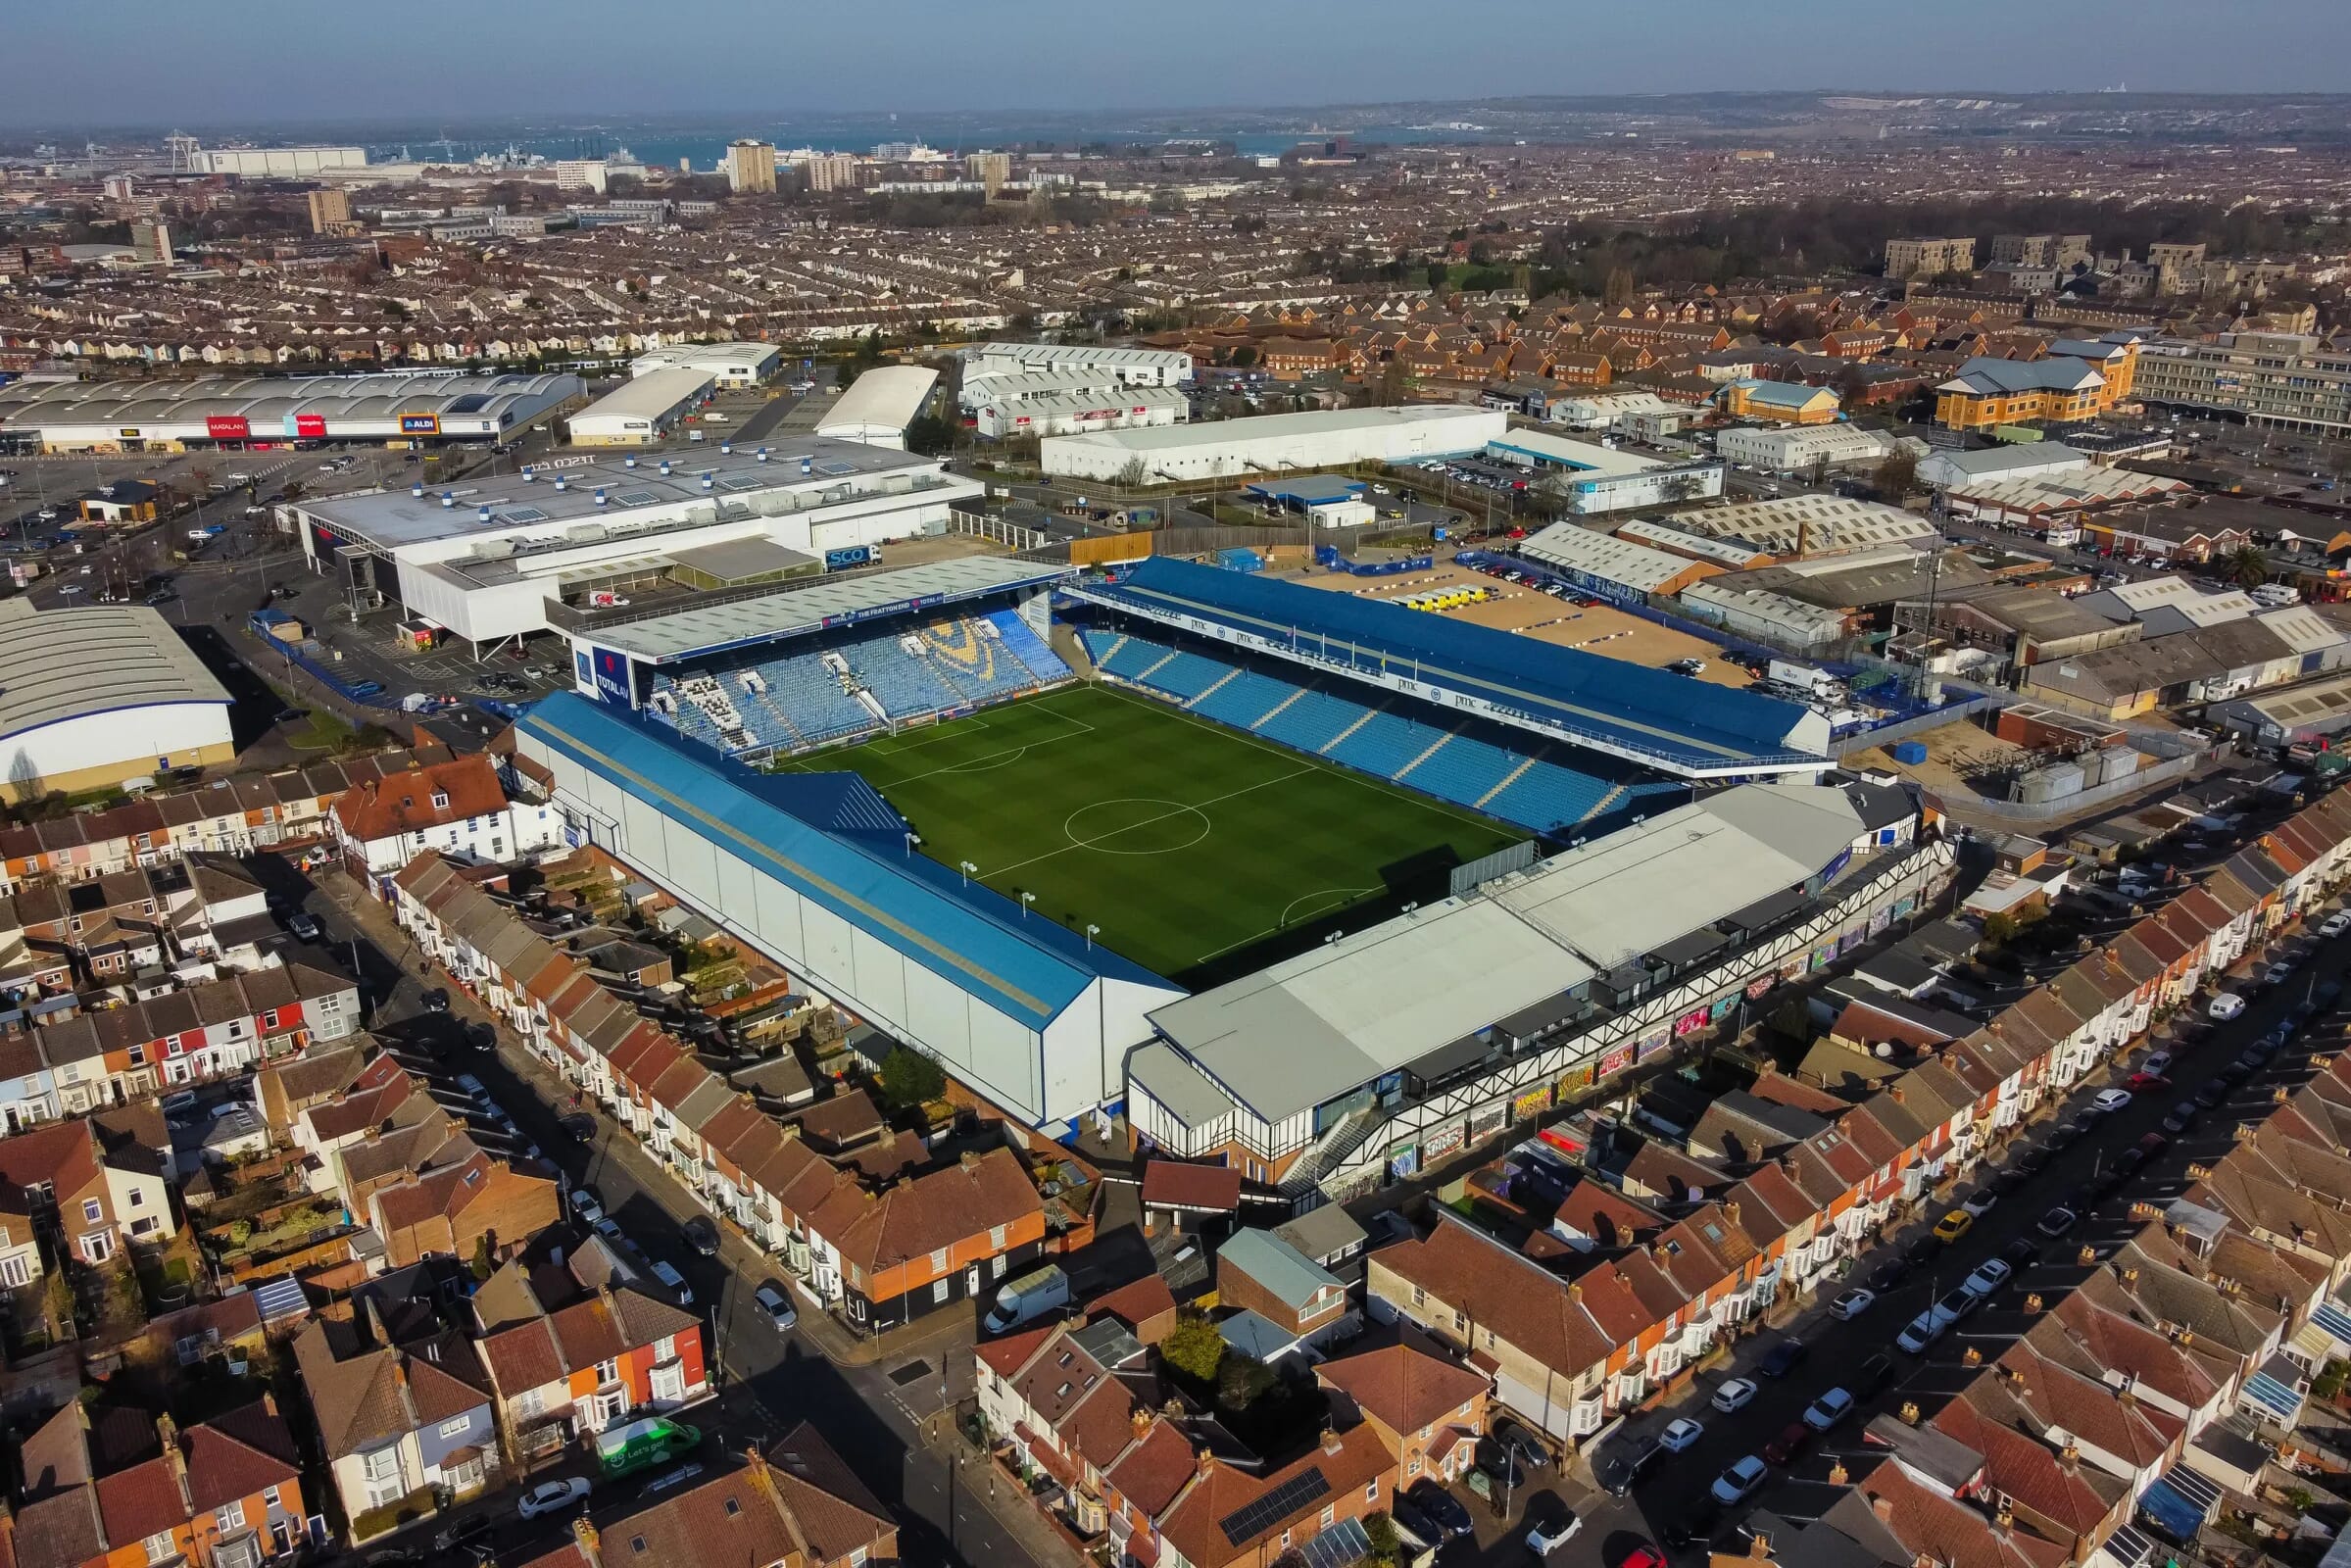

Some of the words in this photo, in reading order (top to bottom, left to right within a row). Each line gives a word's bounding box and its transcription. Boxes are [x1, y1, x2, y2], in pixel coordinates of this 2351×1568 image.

[1191, 619, 1207, 630] pmc
[1237, 632, 1253, 644] pmc
[1398, 678, 1418, 692] pmc
[1455, 695, 1477, 708] pmc
[628, 1446, 649, 1459] Let's
[651, 1439, 664, 1451] go!
